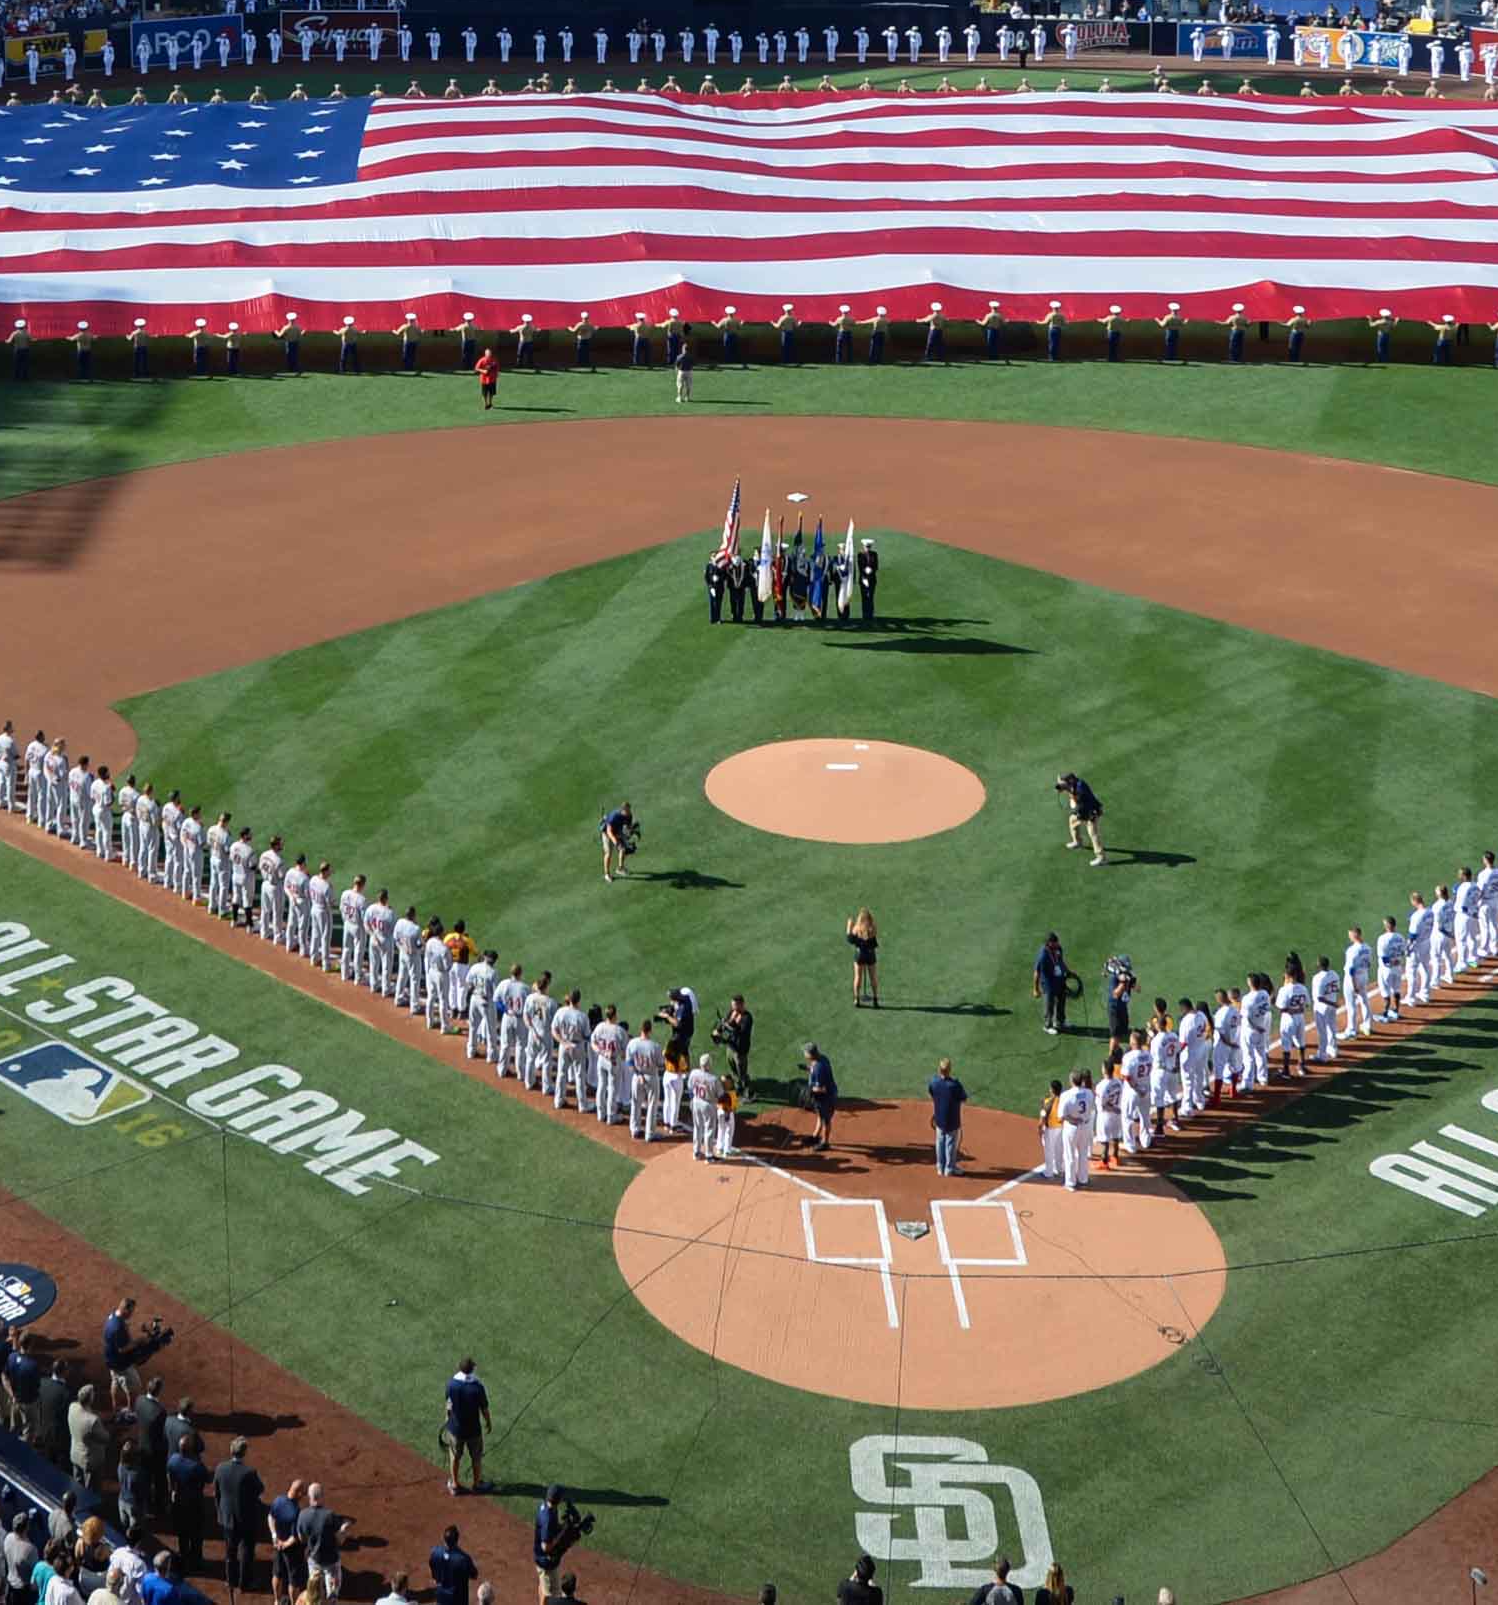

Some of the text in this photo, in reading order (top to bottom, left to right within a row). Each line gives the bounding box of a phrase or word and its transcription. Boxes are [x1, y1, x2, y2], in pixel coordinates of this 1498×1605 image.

[25, 976, 241, 1090] STAR
[186, 1064, 441, 1196] GAME
[113, 1111, 187, 1148] 16
